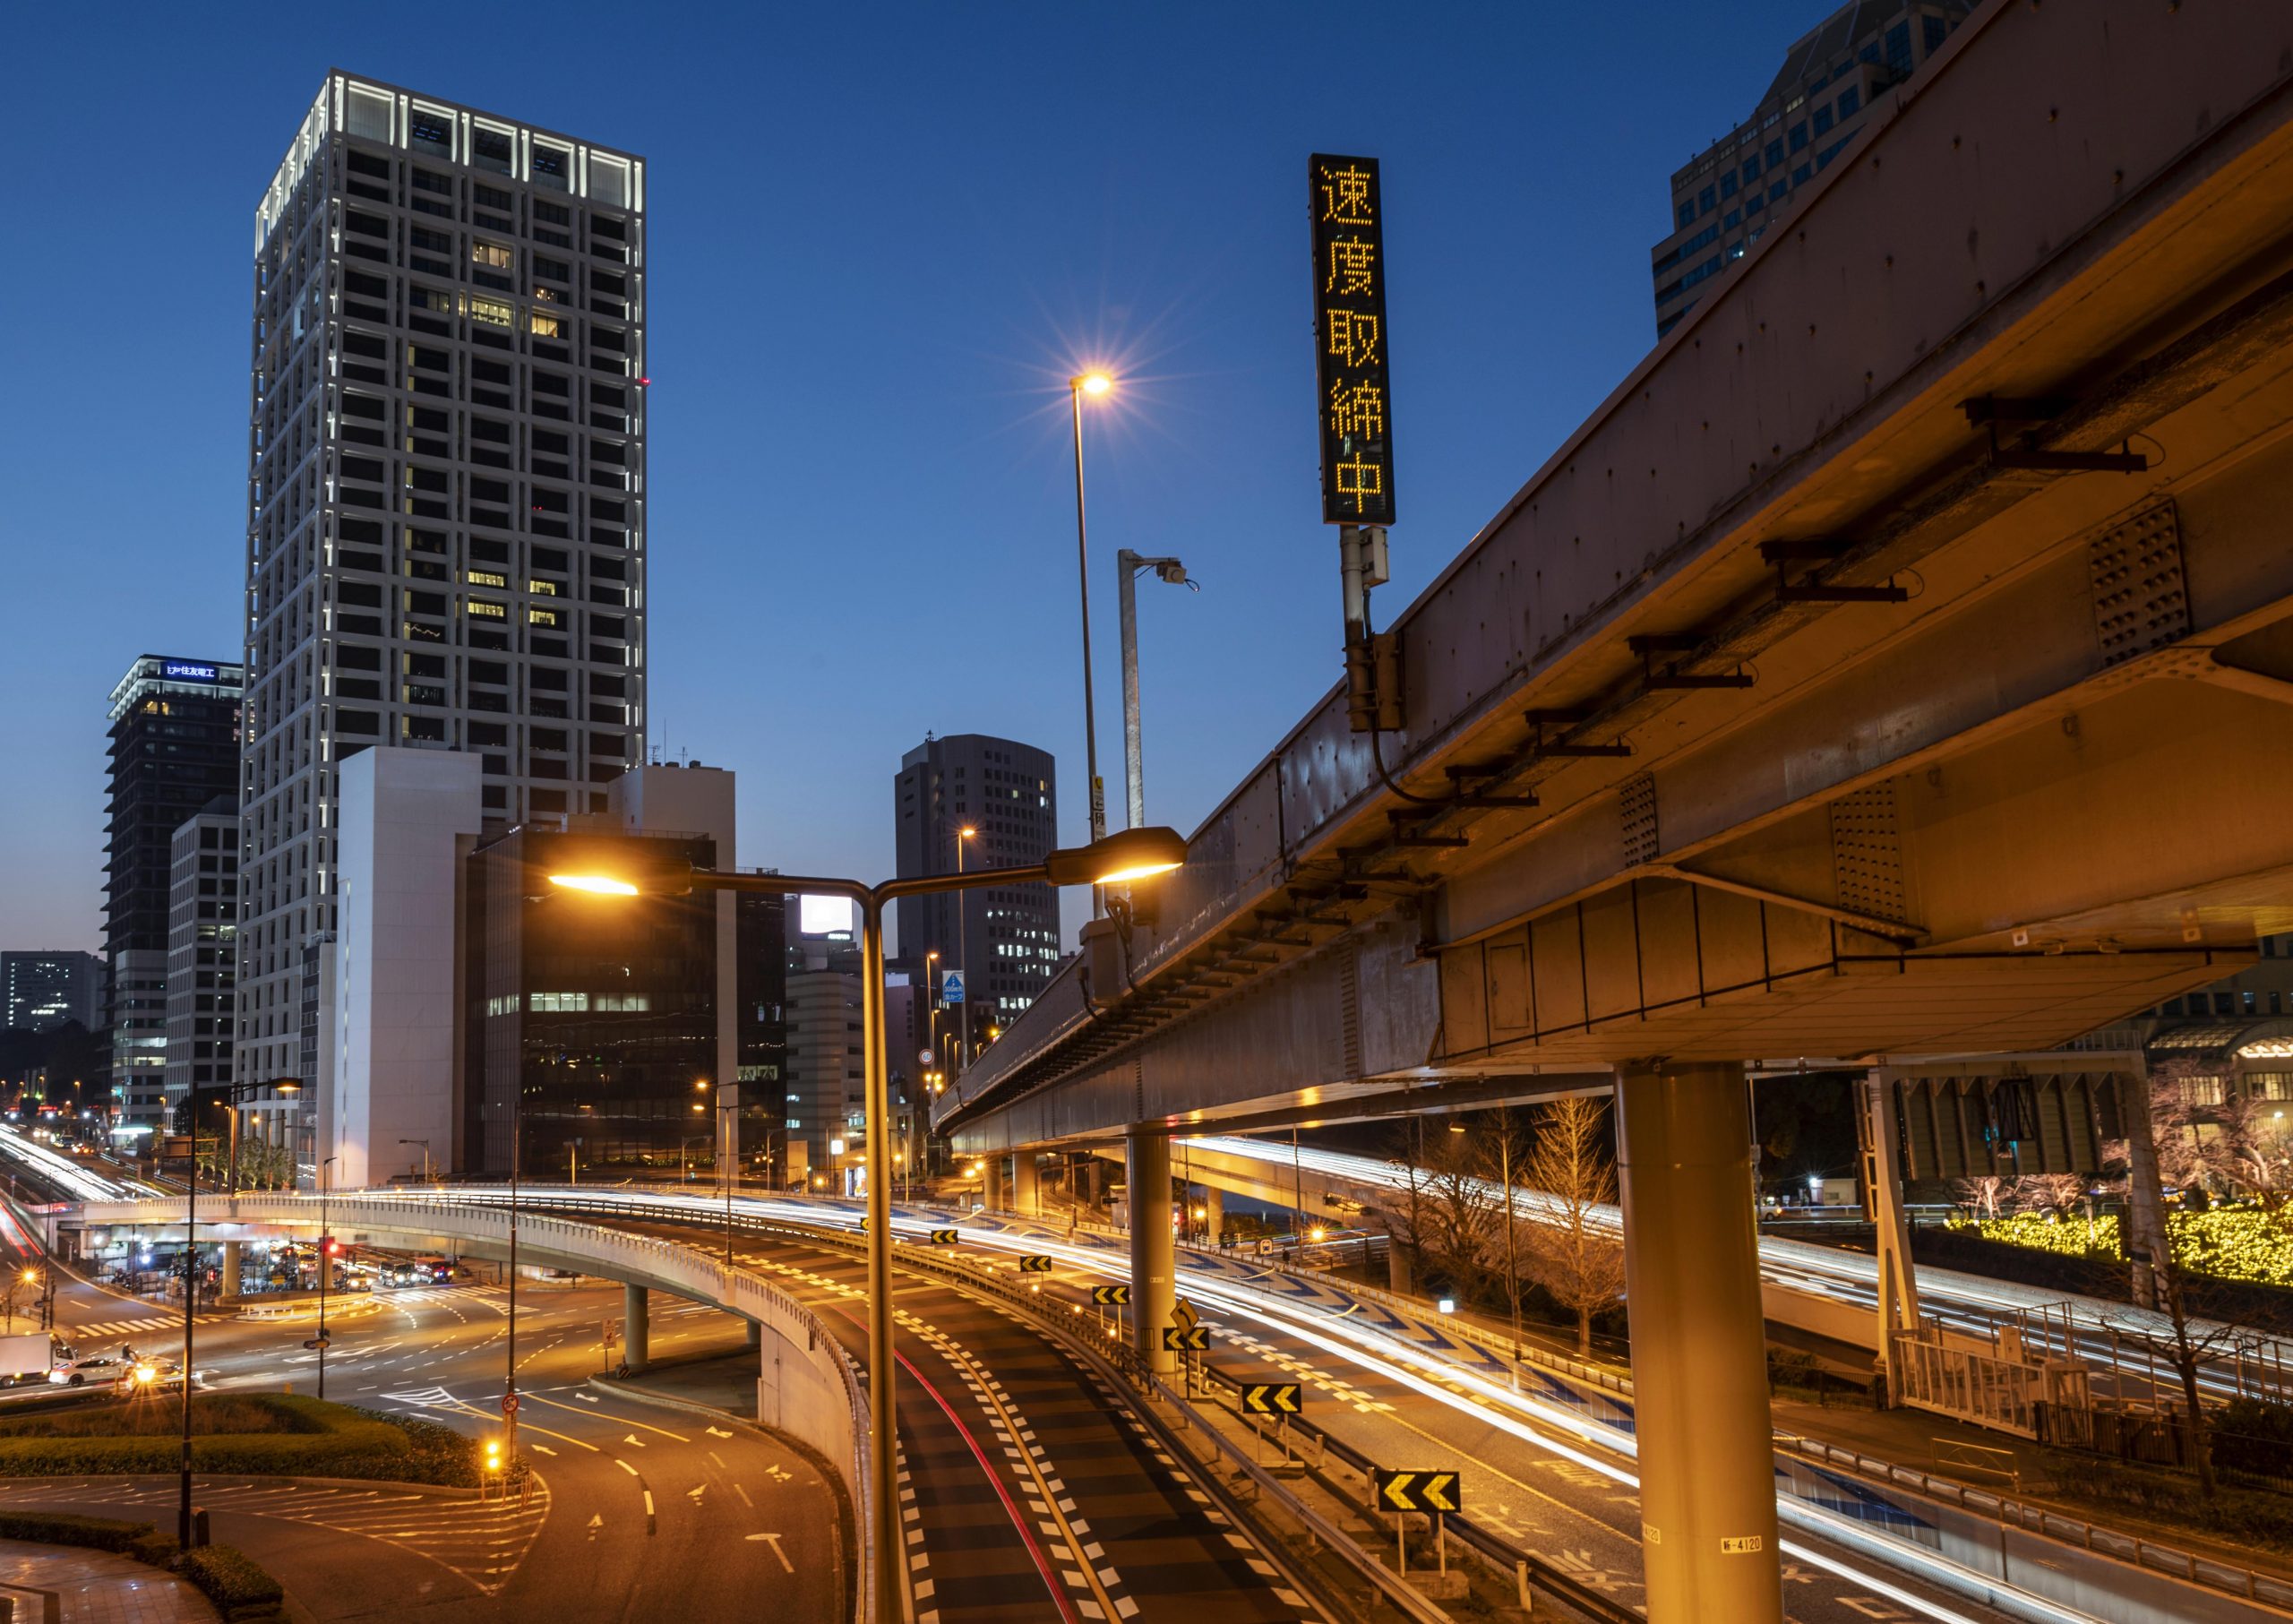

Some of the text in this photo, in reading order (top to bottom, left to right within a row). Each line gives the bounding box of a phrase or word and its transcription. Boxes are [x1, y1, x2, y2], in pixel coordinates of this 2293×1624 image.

[1320, 164, 1383, 514] 速度取締中
